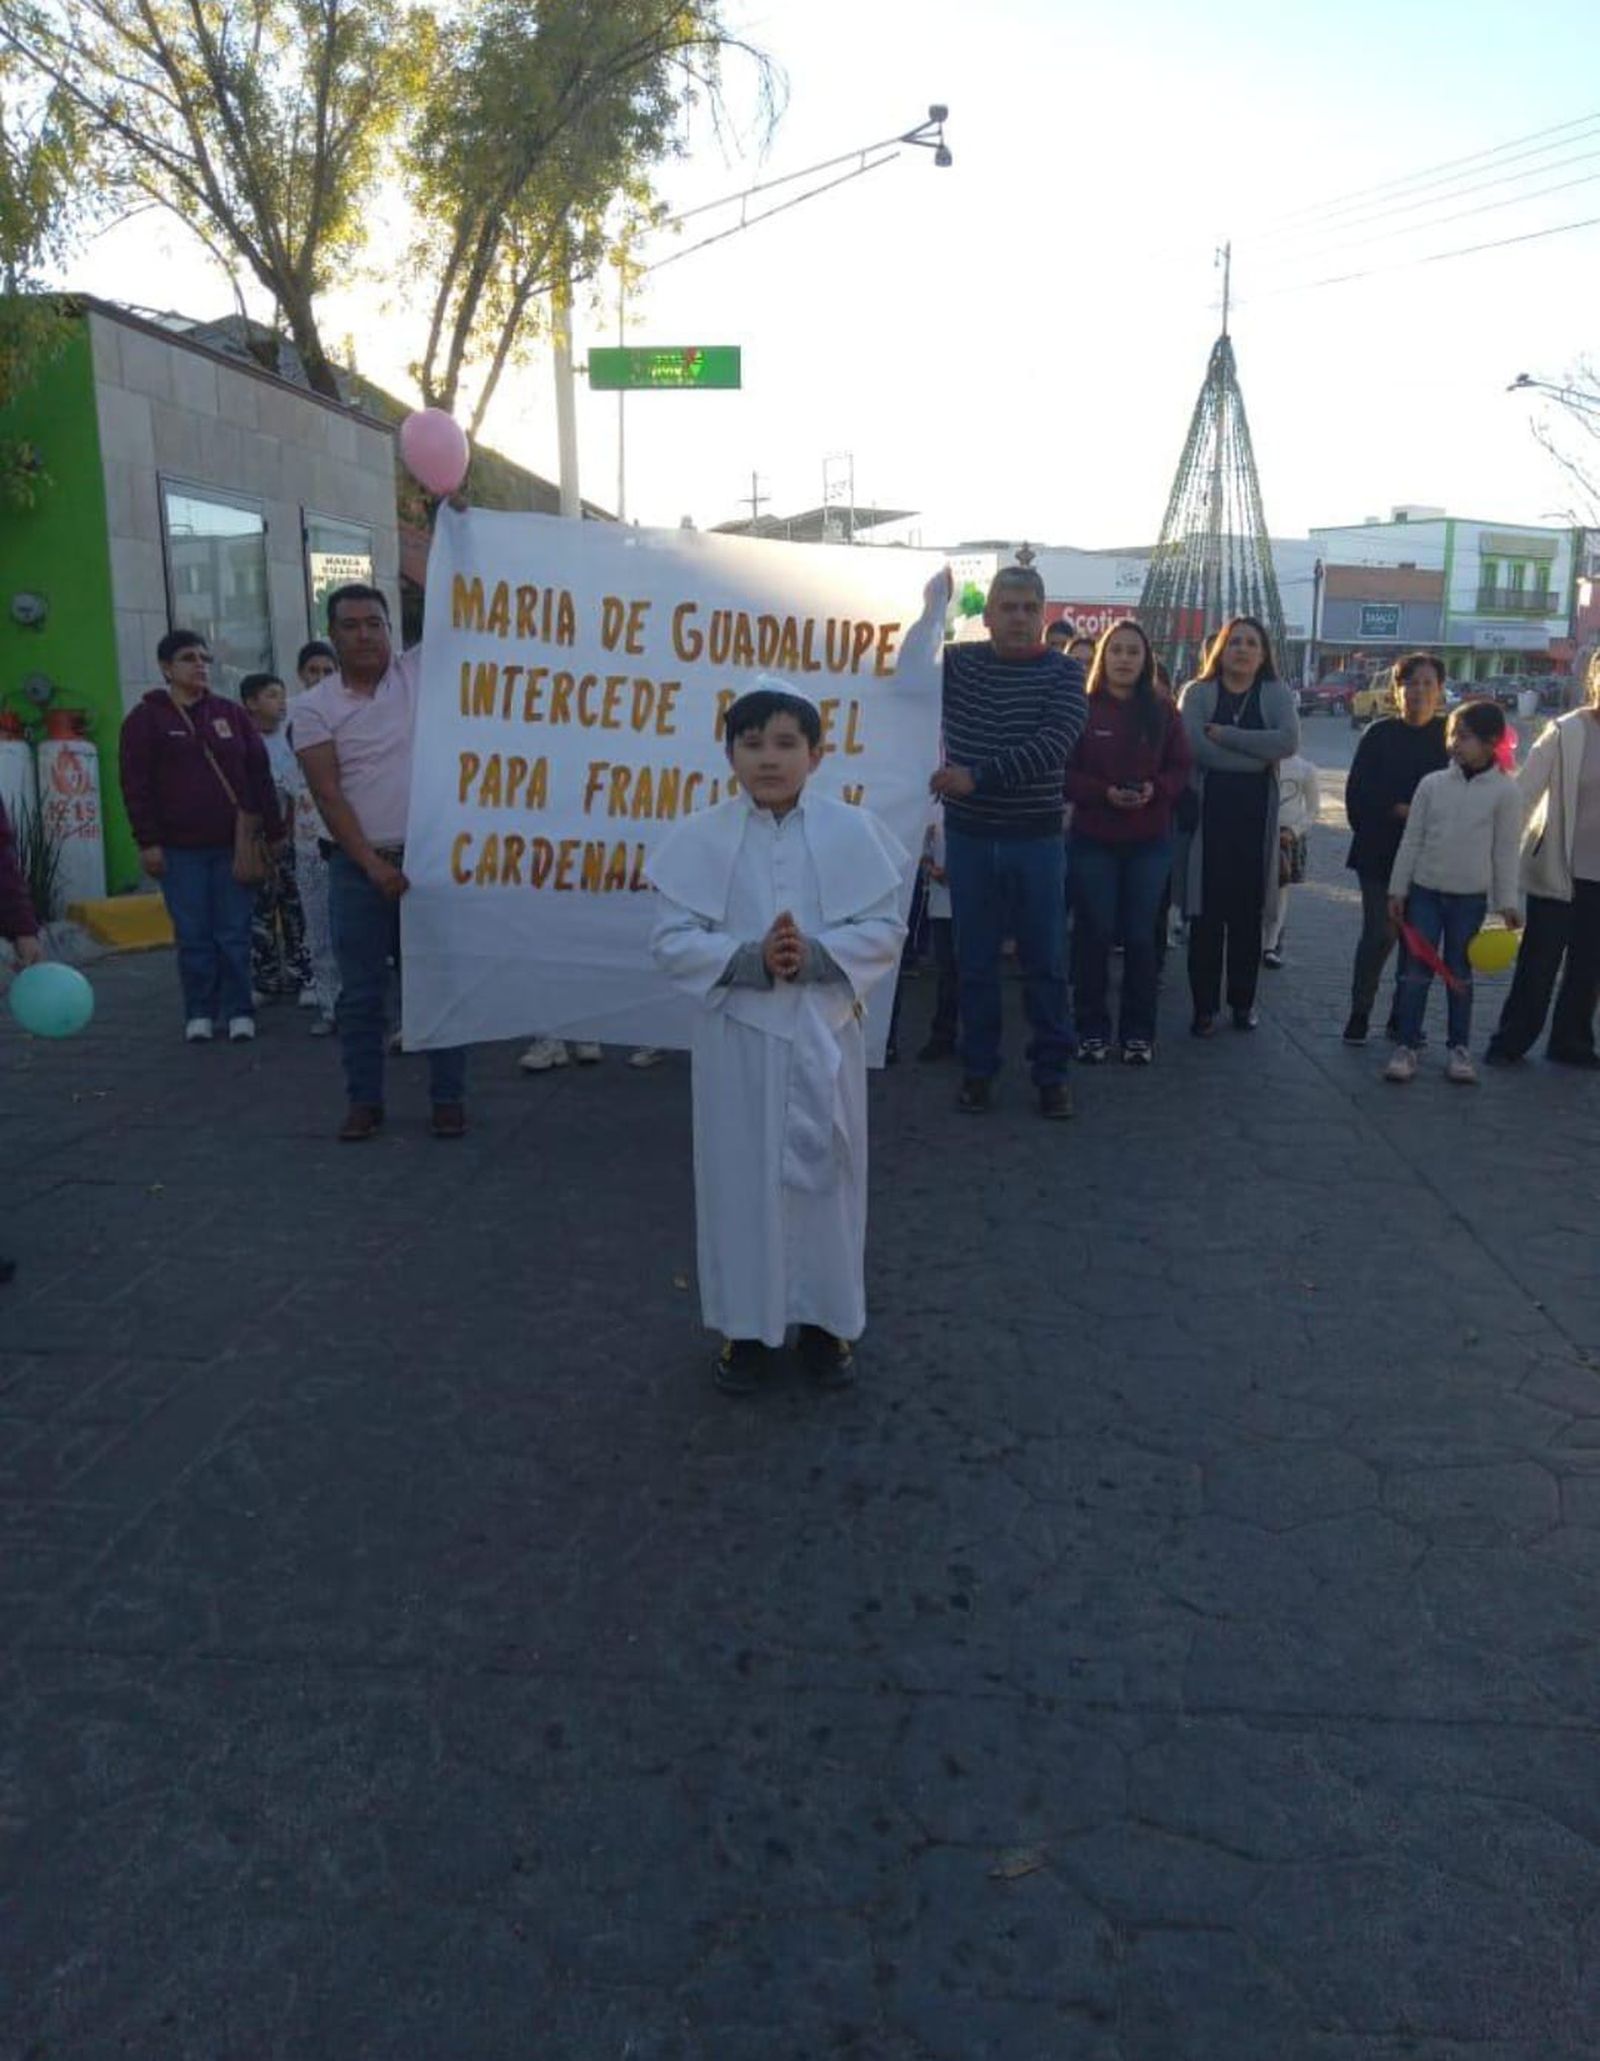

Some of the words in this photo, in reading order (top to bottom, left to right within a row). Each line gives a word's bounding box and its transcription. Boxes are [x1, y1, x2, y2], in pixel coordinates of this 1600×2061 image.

[452, 573, 577, 647] MARIA
[601, 596, 652, 656] DE
[671, 601, 902, 677] GUADALUPE
[459, 660, 682, 736] INTERCEDE
[819, 698, 864, 755] EL
[458, 751, 549, 810] PAPA
